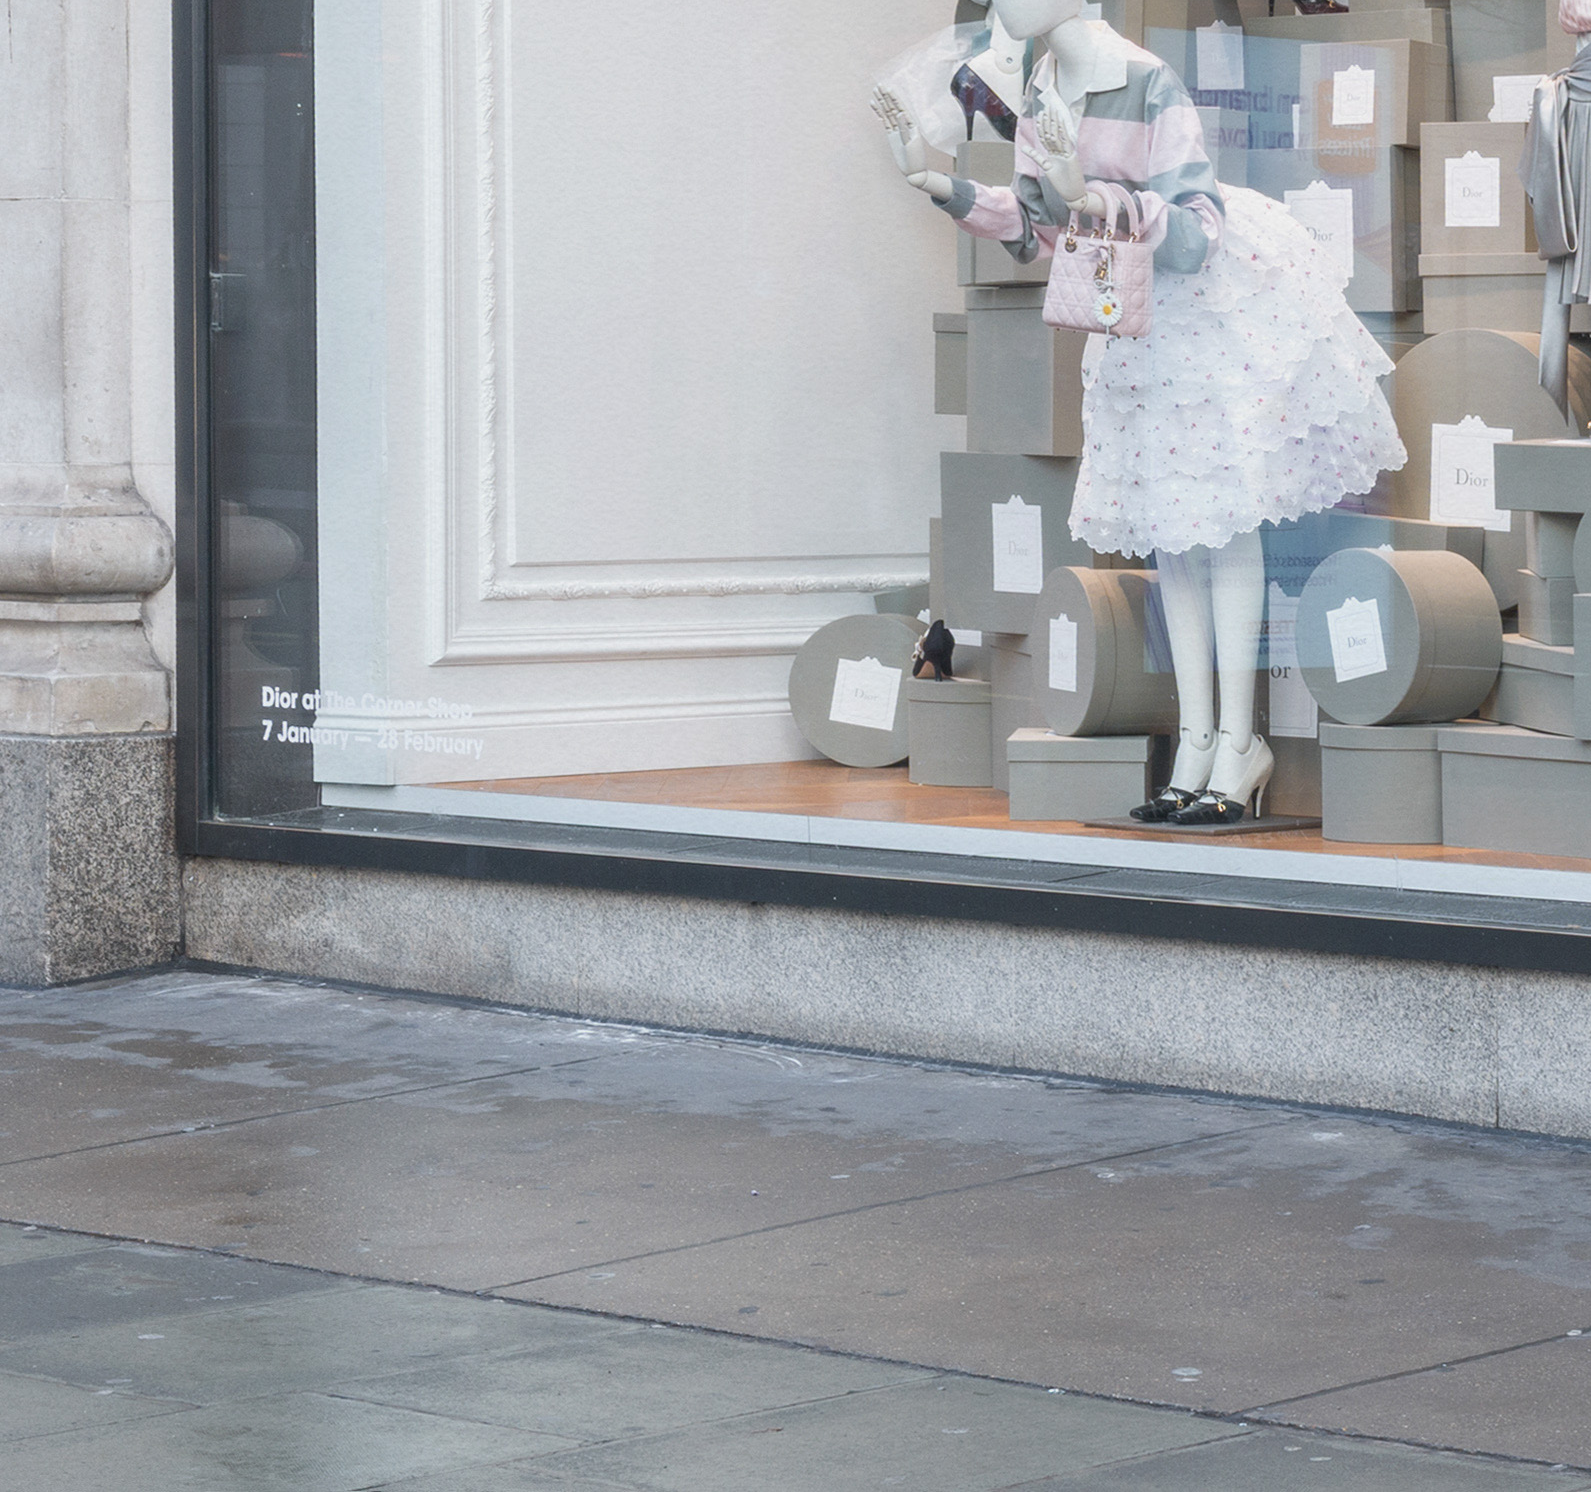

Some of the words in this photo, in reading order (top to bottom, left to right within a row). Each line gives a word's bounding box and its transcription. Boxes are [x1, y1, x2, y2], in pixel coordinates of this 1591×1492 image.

[1462, 186, 1484, 199] Dior
[1454, 467, 1489, 488] Dior
[1347, 635, 1368, 649] Dior
[262, 685, 298, 709] Dior
[302, 689, 320, 710] at
[325, 690, 356, 707] The
[361, 692, 424, 717] Corner
[854, 686, 878, 702] Dior
[262, 719, 273, 741] 7
[276, 721, 349, 751] January
[376, 729, 398, 749] 28
[404, 729, 484, 760] February
